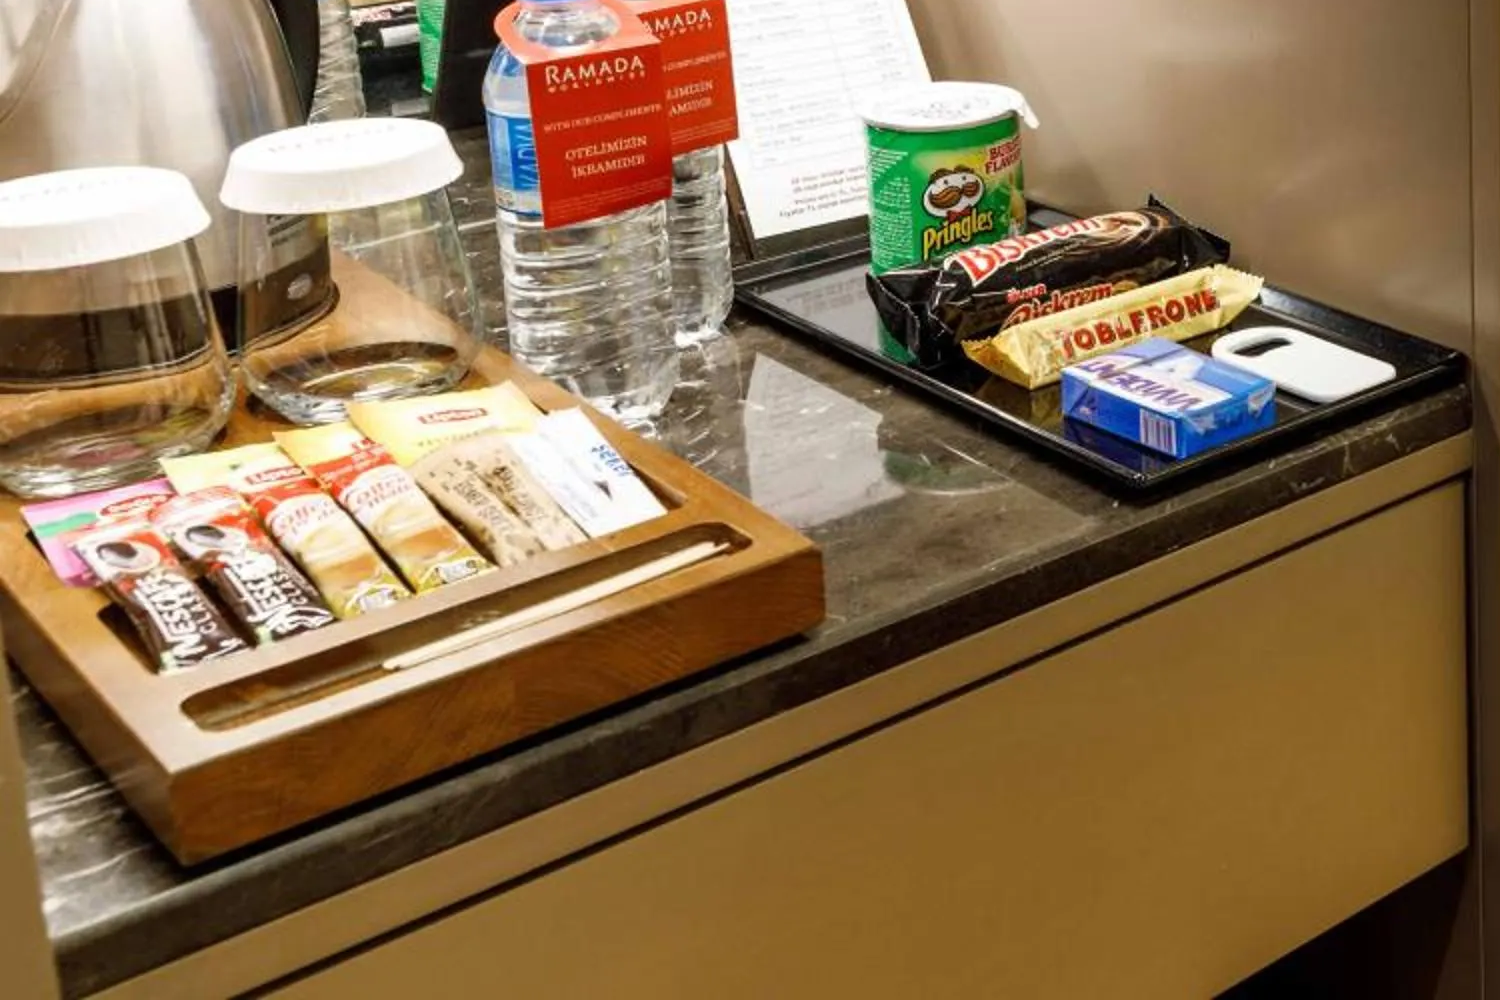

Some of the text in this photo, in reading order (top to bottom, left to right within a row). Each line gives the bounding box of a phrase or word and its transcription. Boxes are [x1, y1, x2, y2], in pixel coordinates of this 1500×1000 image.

[642, 7, 711, 34] AMADA
[545, 55, 645, 86] RAMADA
[923, 209, 994, 262] Pringles
[957, 215, 1102, 283] Biskrem
[1057, 287, 1222, 361] TOBLERONE
